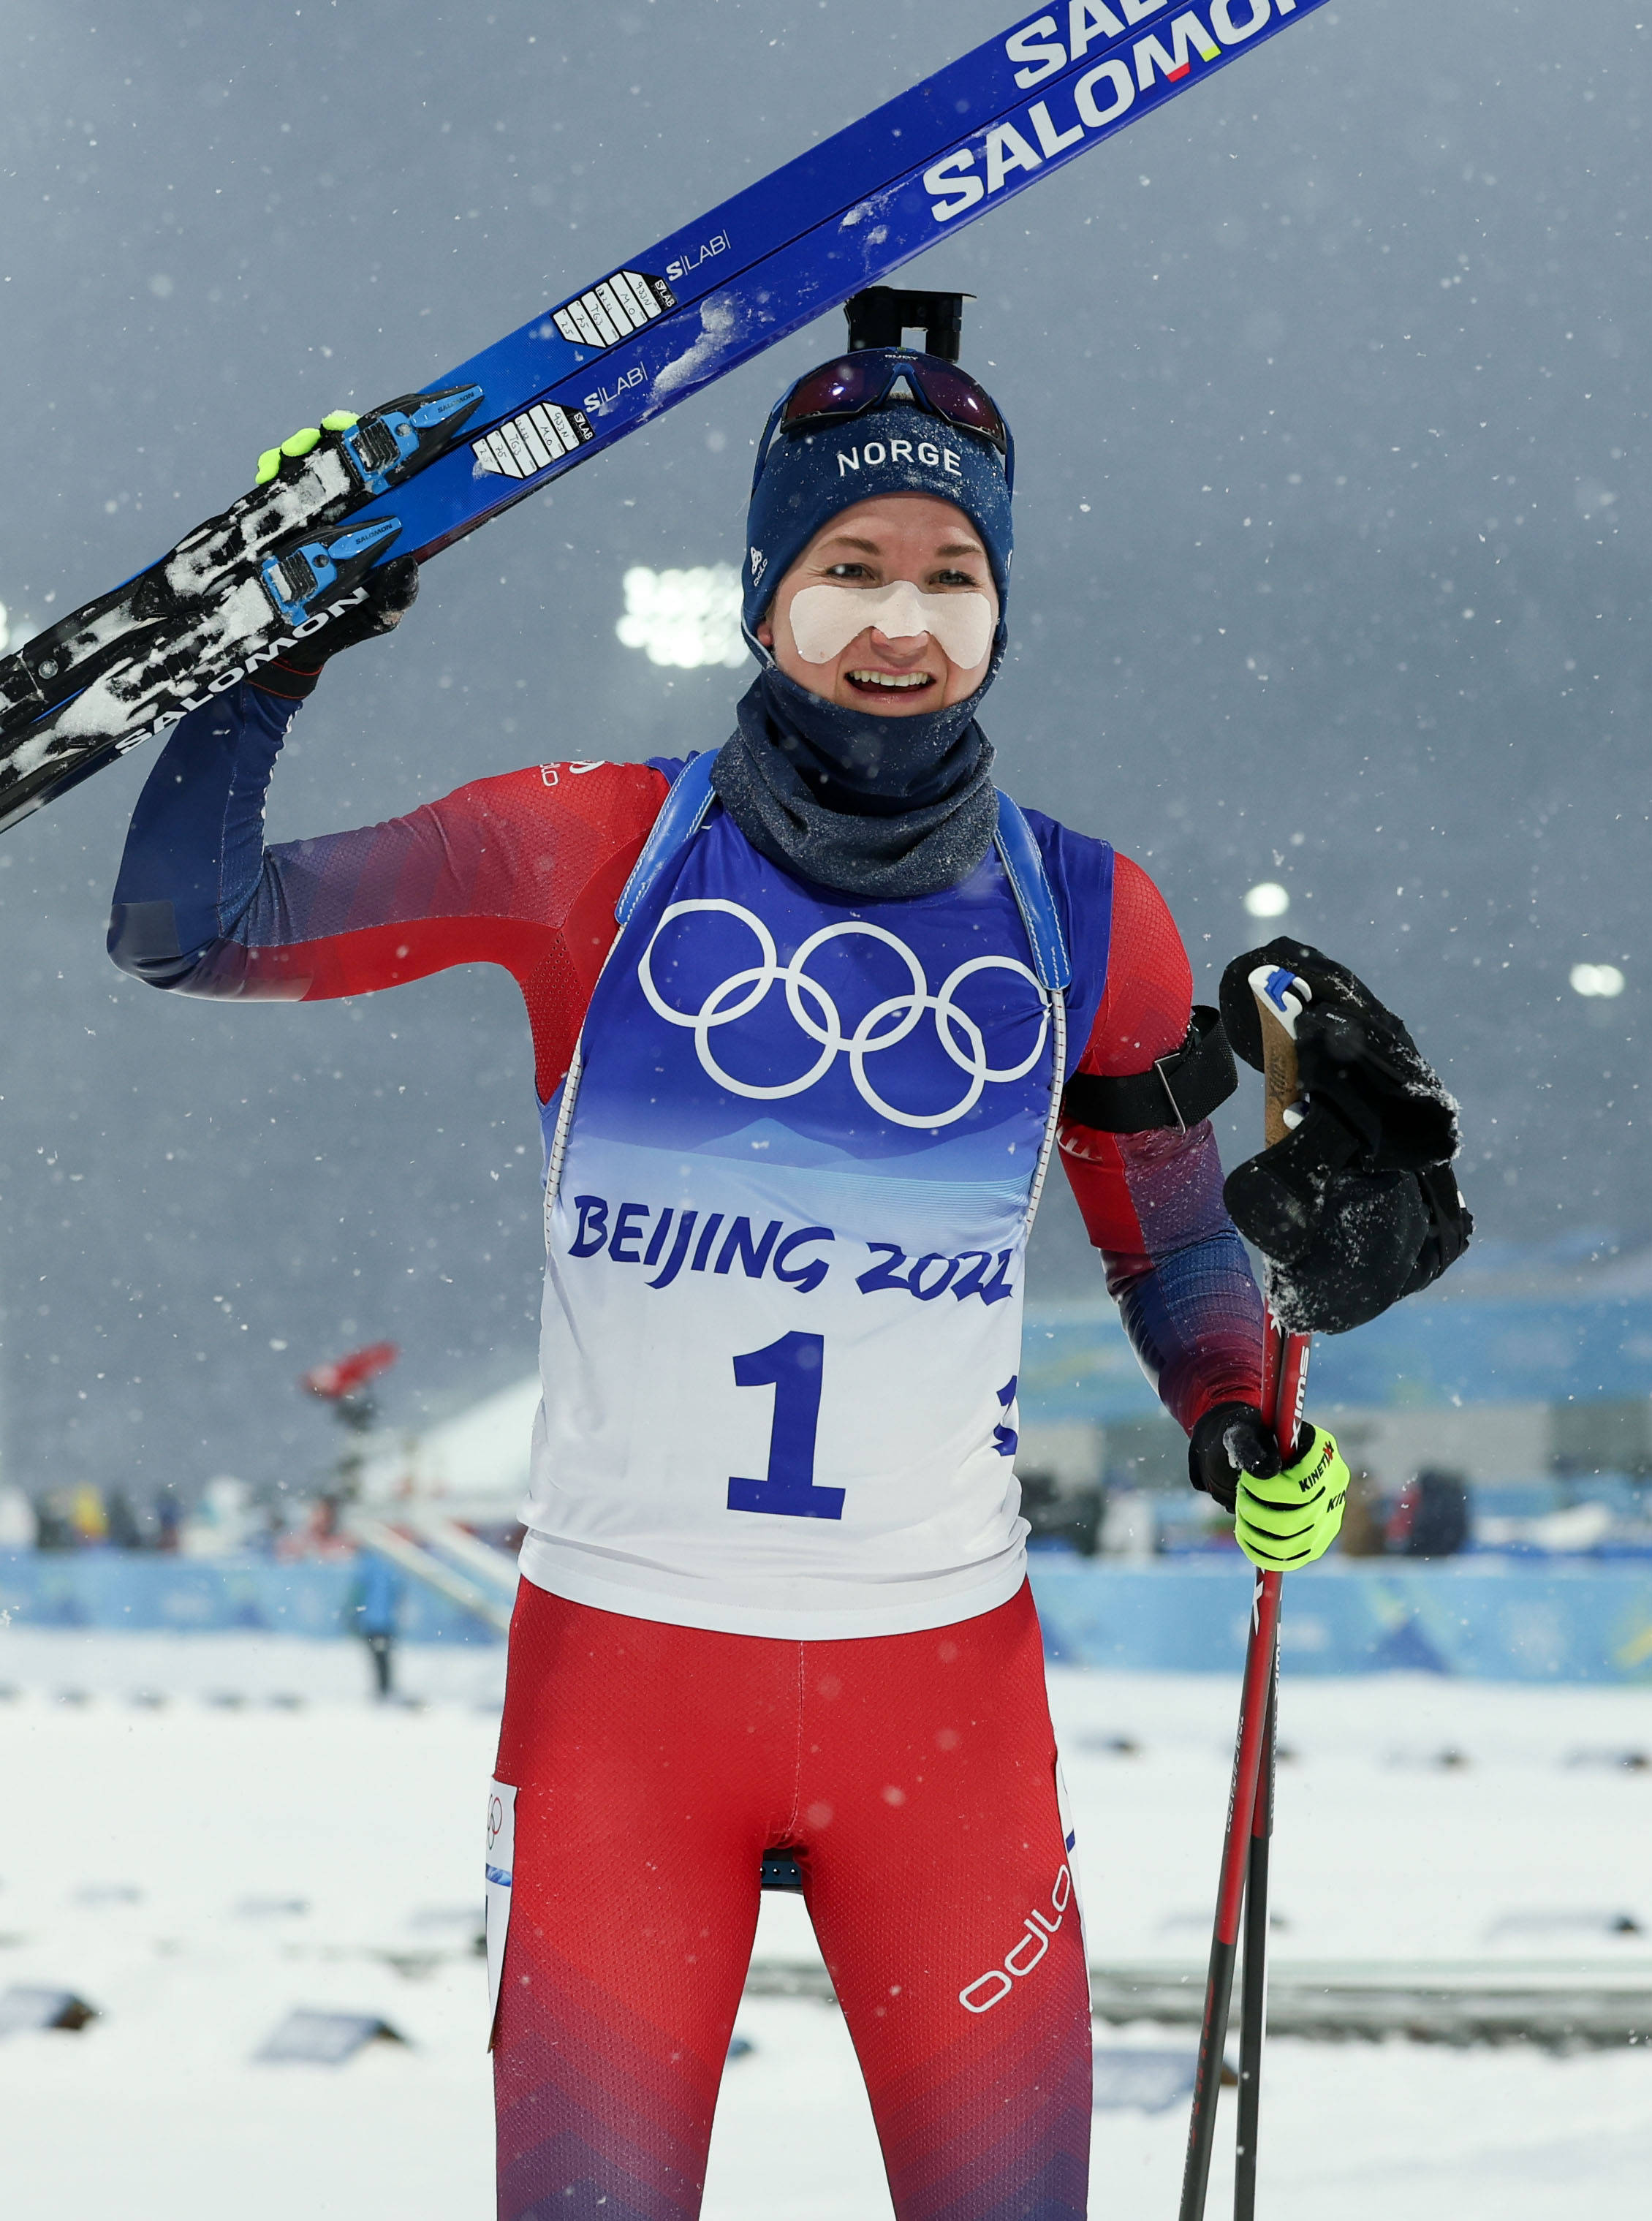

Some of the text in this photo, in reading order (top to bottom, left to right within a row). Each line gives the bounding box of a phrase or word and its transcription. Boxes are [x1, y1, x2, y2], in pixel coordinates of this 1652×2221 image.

[922, 0, 1297, 222] SALOMO
[837, 439, 963, 477] NORGE
[355, 523, 393, 545] SALOMON
[115, 586, 370, 755] SALOMON
[567, 1195, 836, 1293] BEIJING
[726, 1330, 846, 1521] 1
